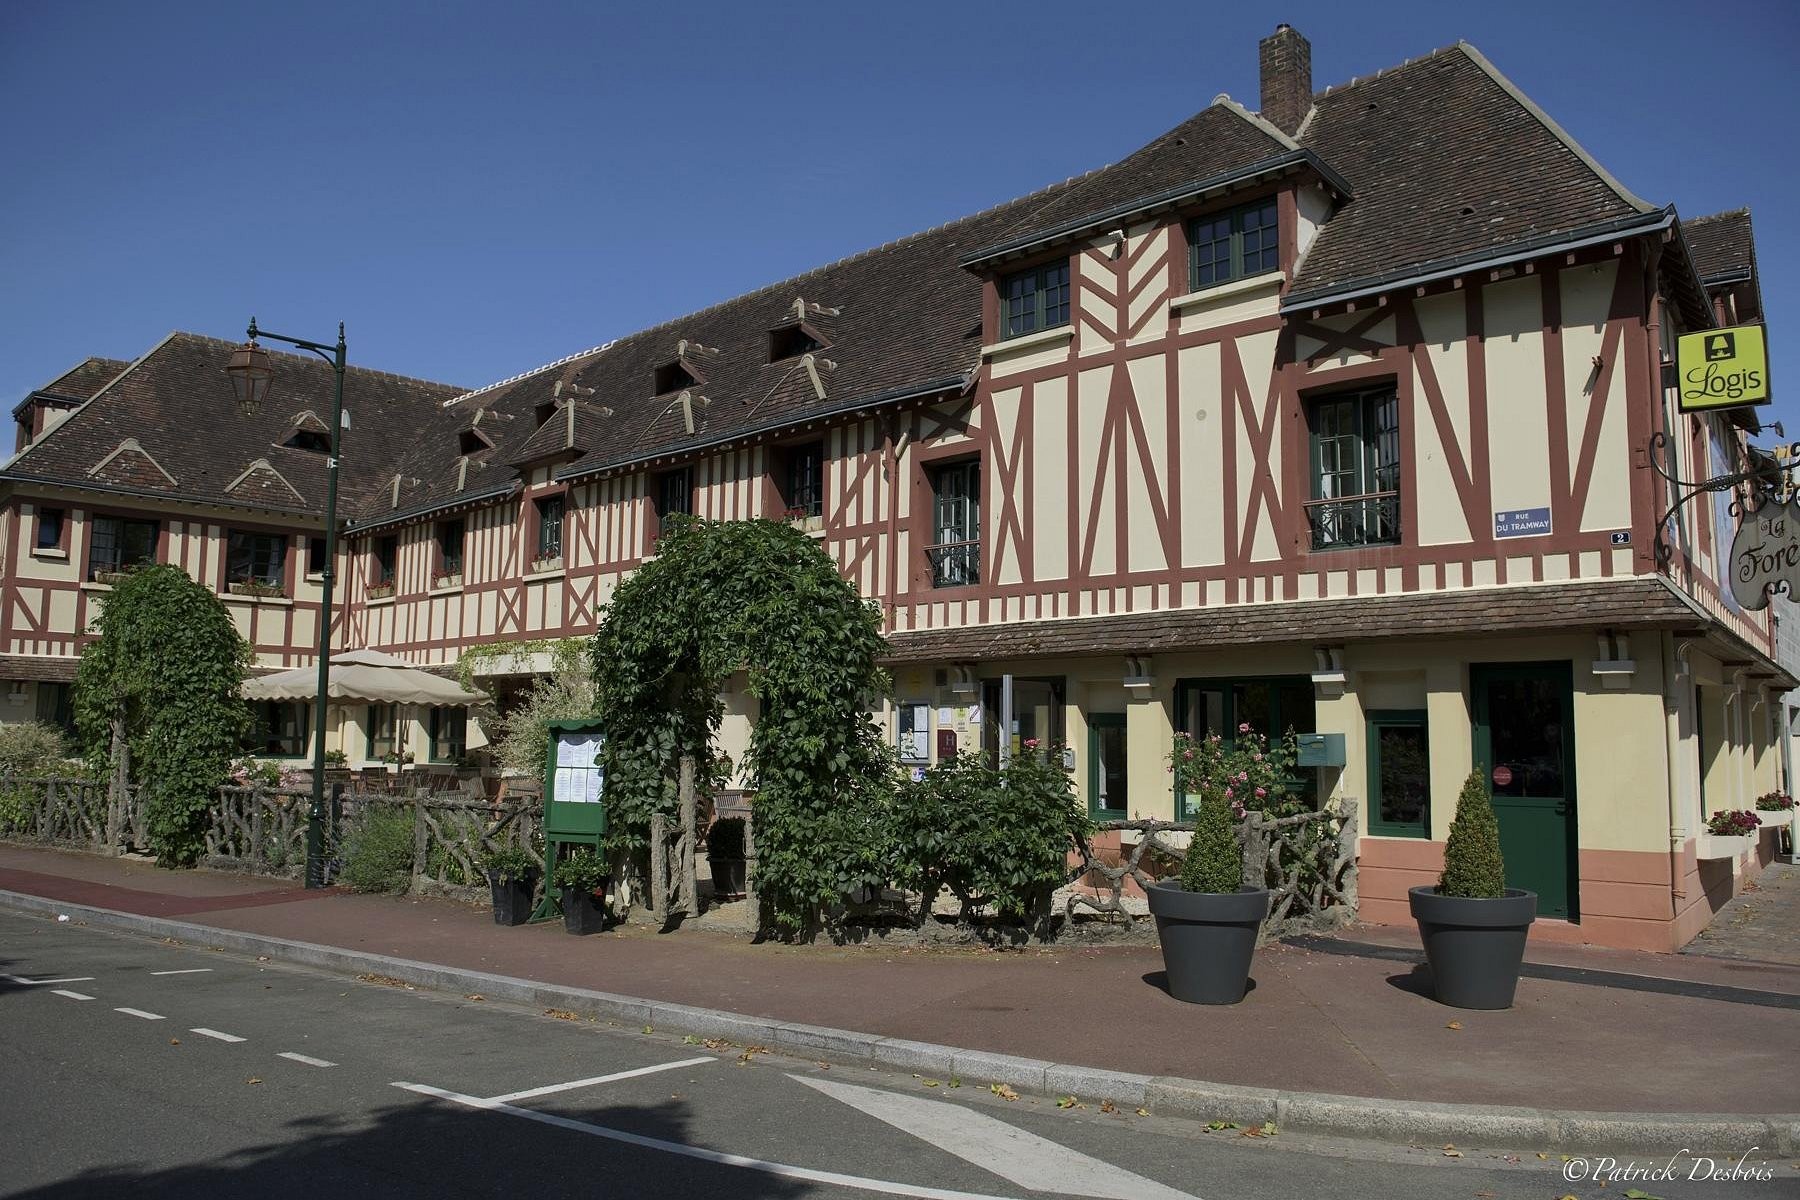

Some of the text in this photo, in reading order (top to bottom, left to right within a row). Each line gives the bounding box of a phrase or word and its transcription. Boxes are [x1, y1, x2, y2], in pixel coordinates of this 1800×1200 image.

[1684, 363, 1761, 399] Logis
[1511, 520, 1549, 531] TRAMWAY
[1761, 519, 1785, 538] La
[1617, 534, 1624, 543] 2
[946, 735, 954, 746] H
